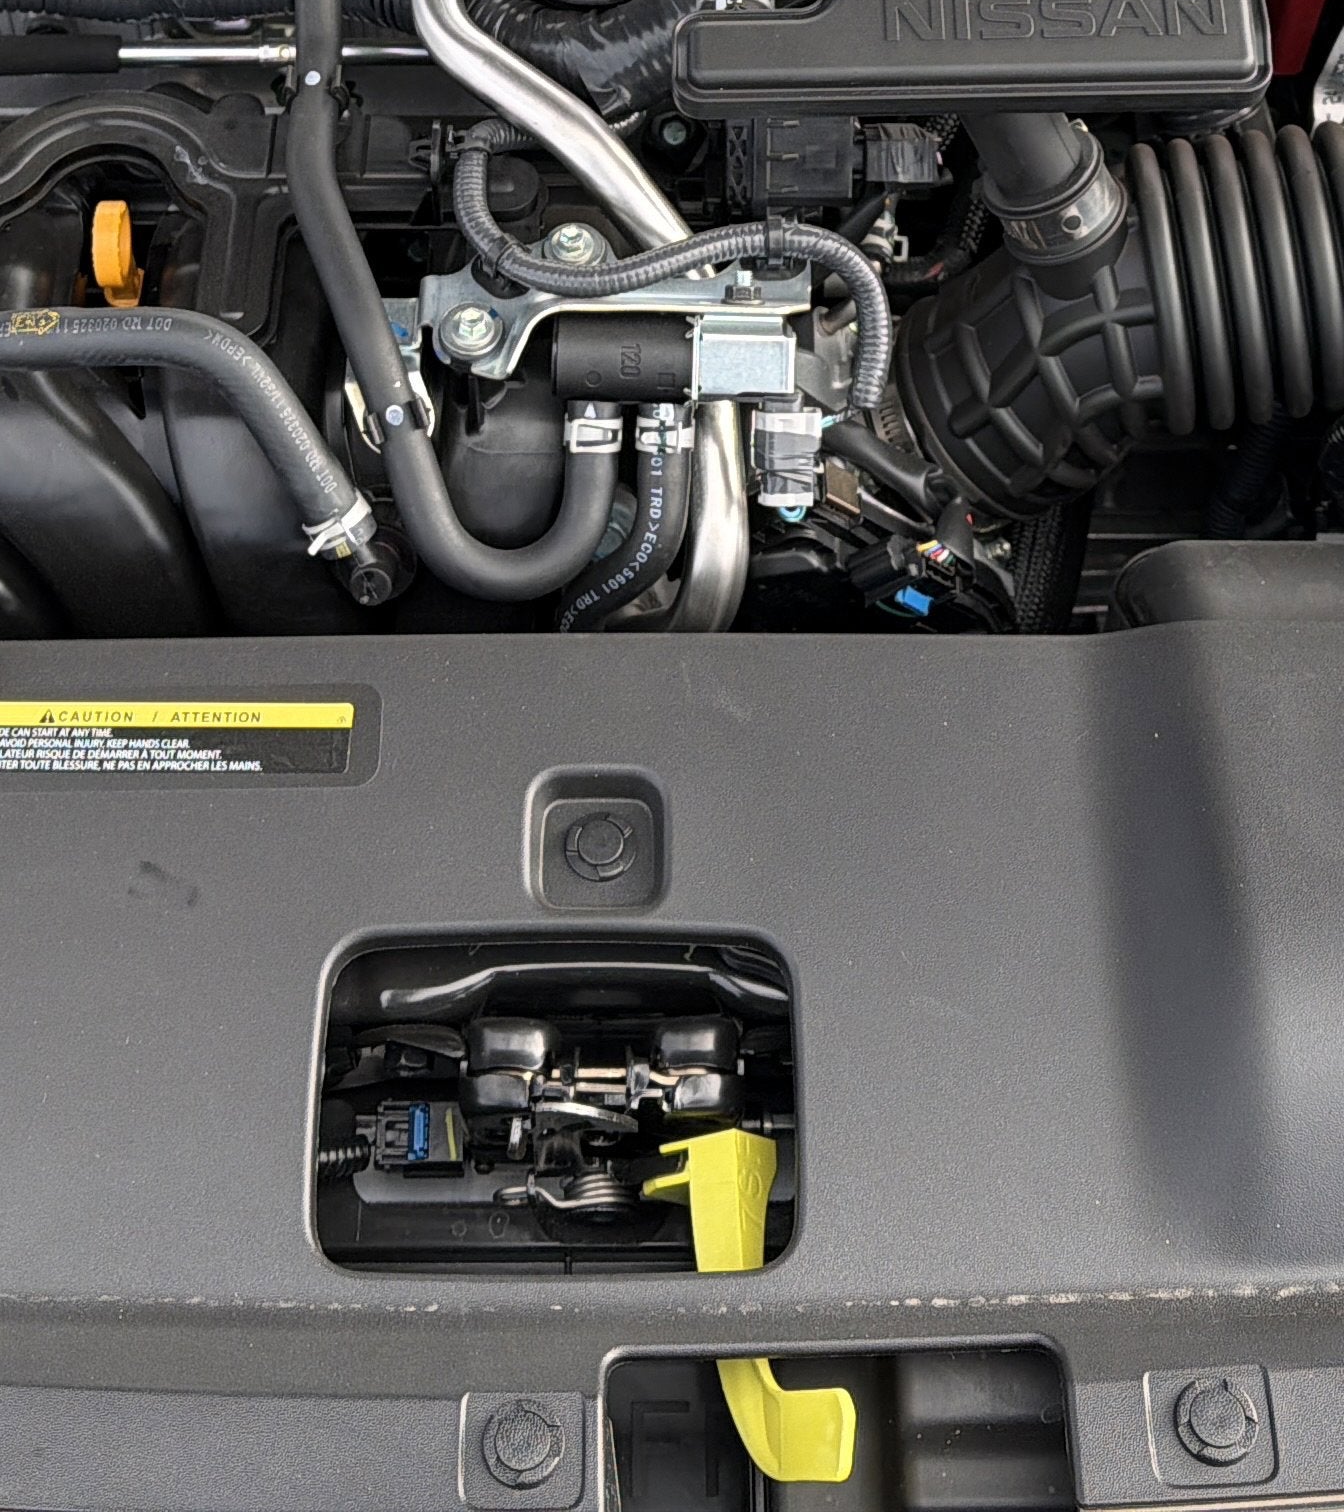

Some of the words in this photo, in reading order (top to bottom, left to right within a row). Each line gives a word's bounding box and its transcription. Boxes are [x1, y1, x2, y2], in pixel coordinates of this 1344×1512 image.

[618, 343, 643, 380] 120
[58, 711, 133, 722] CAUTION
[171, 712, 261, 722] ATTENTION
[58, 728, 70, 737] AT
[72, 749, 86, 759] DE
[140, 750, 147, 760] À
[103, 760, 116, 771] NE
[137, 760, 151, 771] EN
